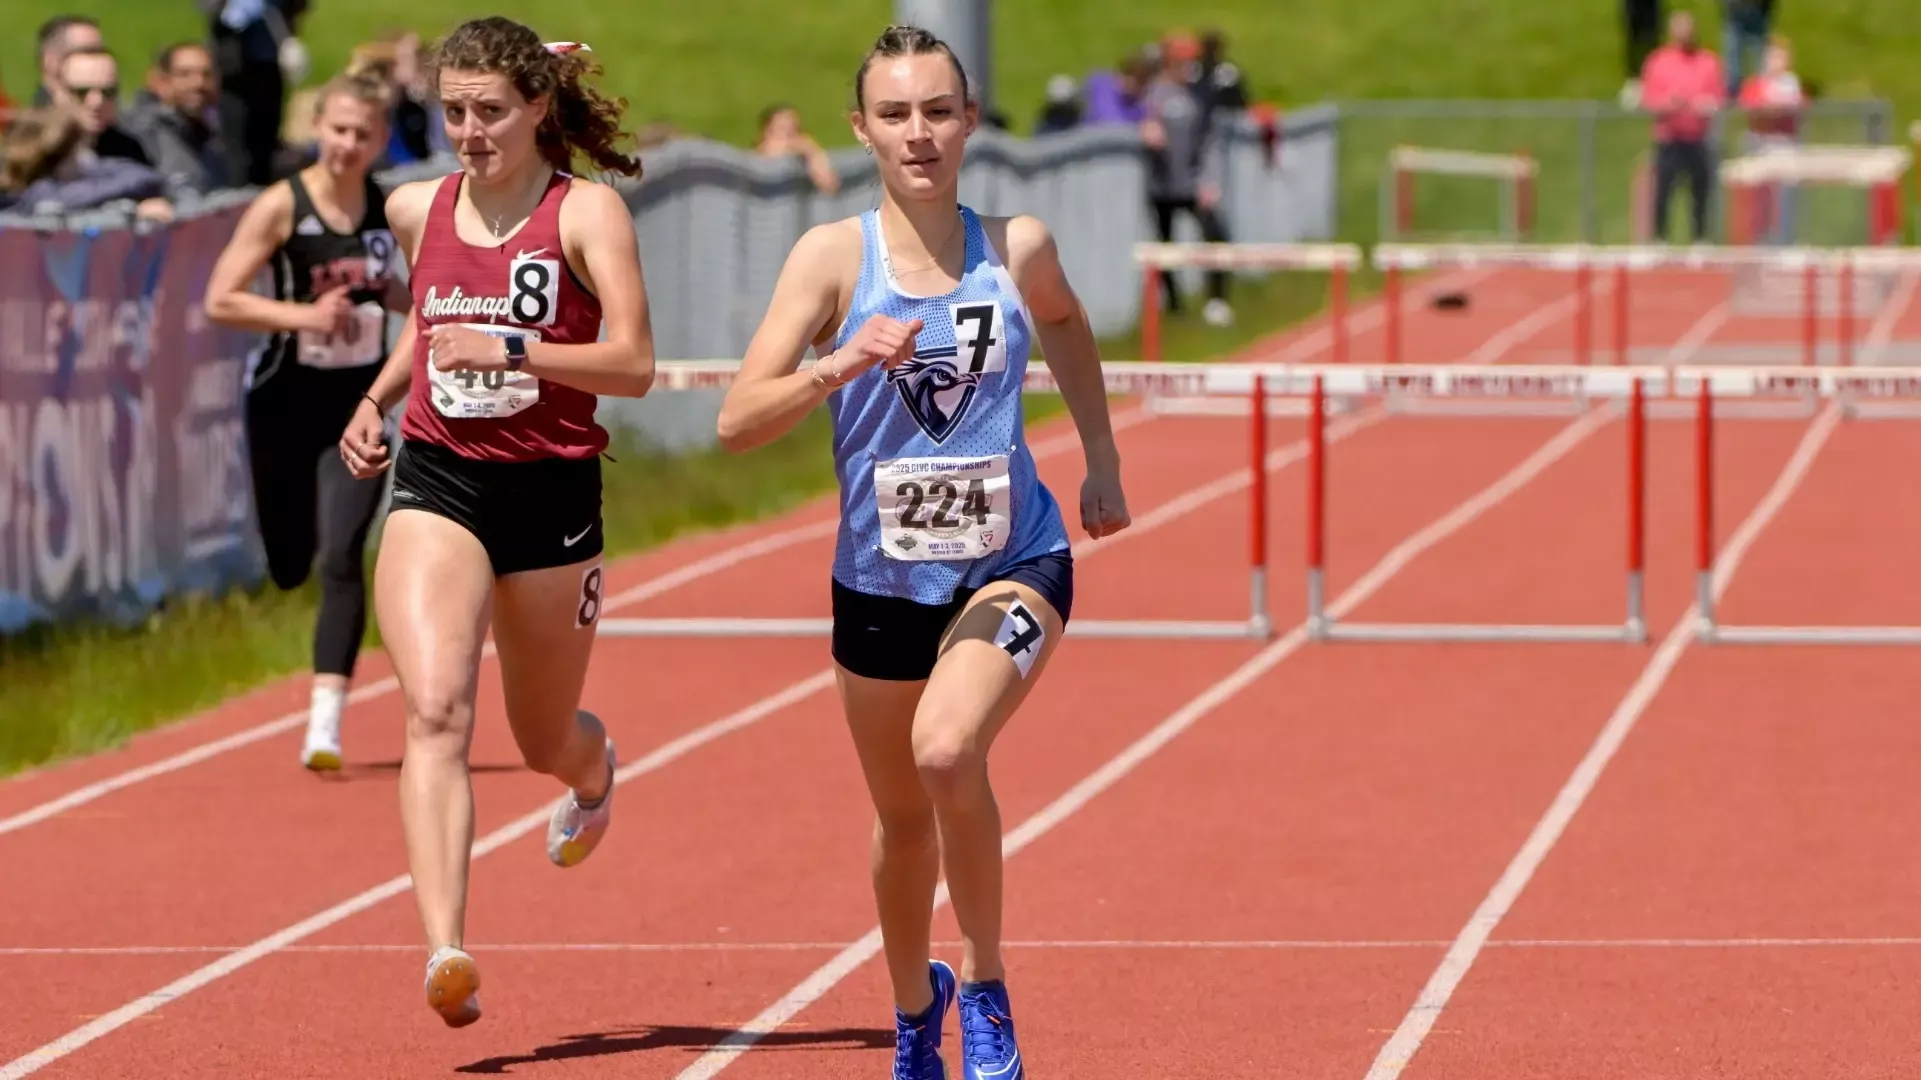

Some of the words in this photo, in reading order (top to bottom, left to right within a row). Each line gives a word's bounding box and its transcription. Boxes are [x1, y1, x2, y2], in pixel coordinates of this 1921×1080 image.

[370, 236, 388, 276] 9
[421, 286, 510, 324] Indianap
[512, 262, 549, 324] 8
[956, 304, 996, 373] 7
[930, 460, 992, 471] CHAMPIONSHIPS
[896, 478, 991, 528] 224
[578, 567, 601, 627] 8
[1002, 604, 1042, 657] 7
